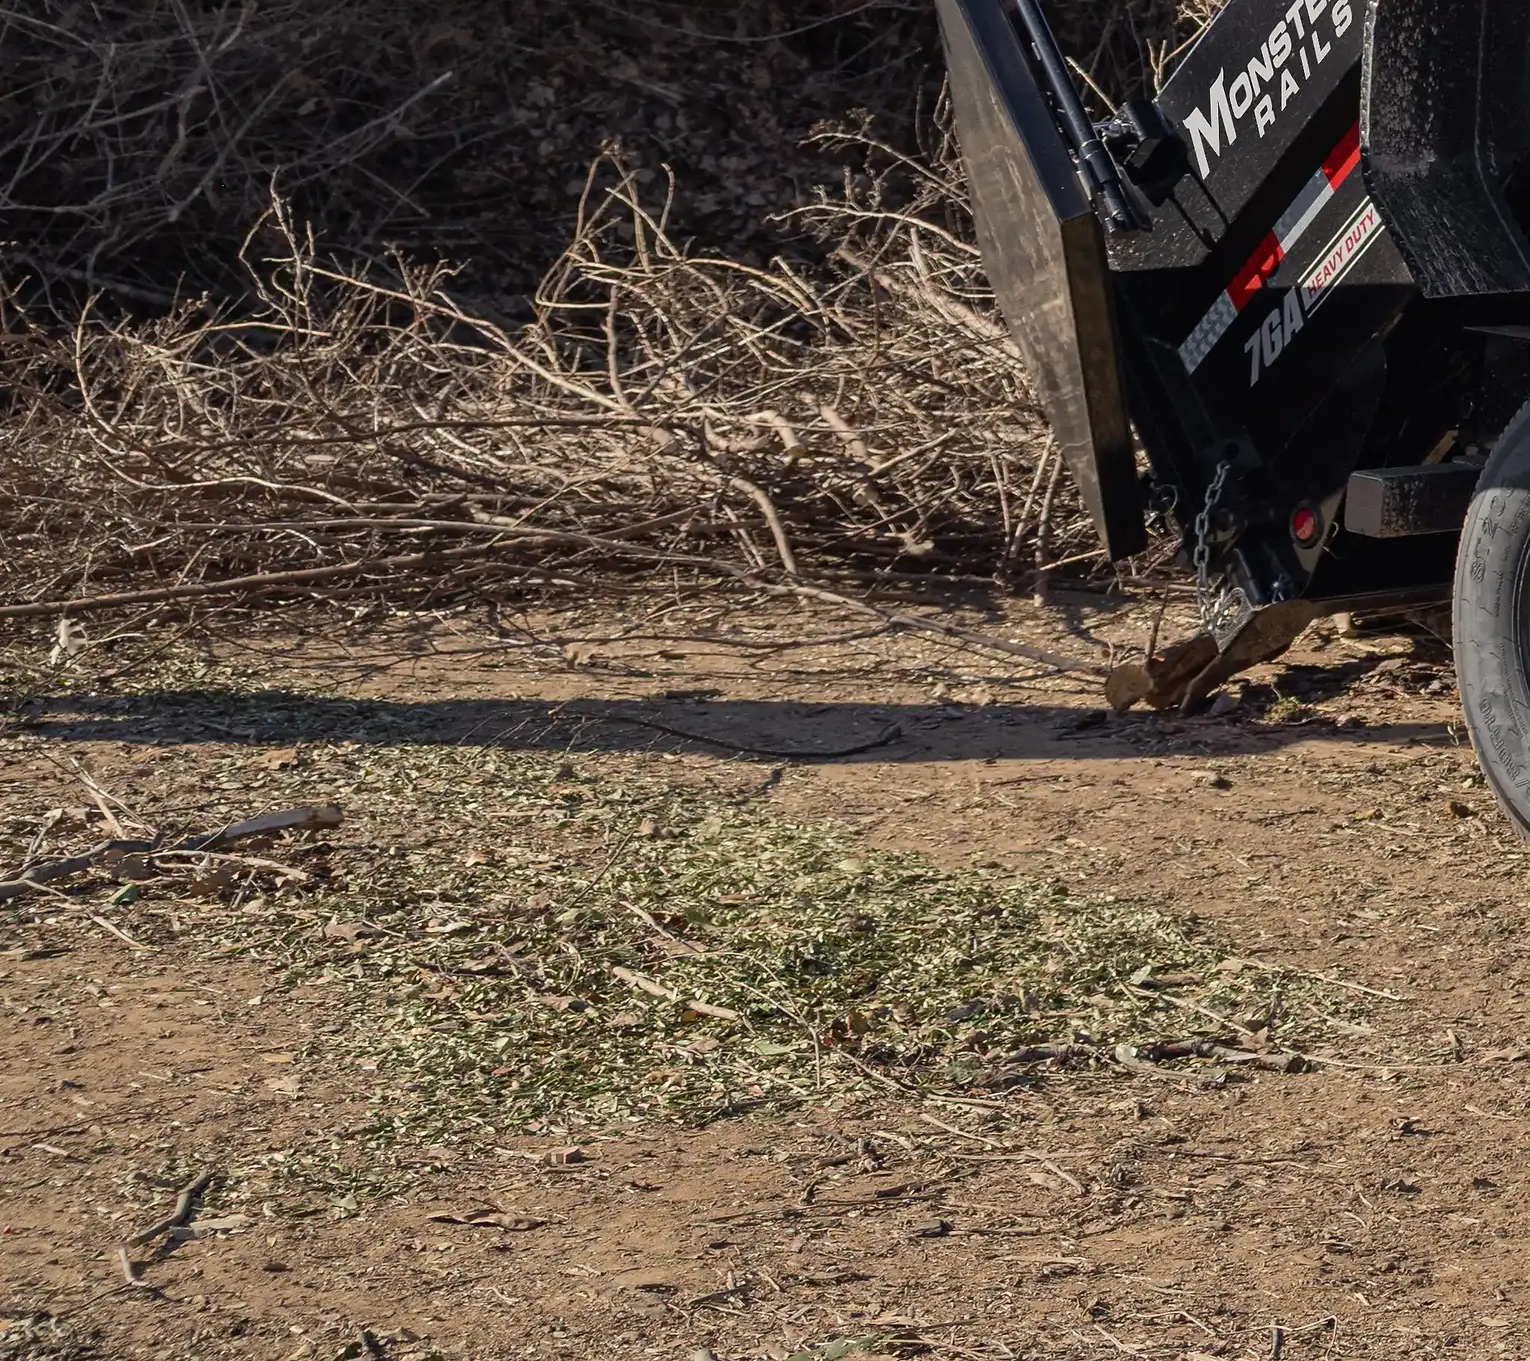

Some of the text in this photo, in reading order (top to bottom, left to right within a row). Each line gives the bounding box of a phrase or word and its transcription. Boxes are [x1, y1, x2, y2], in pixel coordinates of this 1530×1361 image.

[1244, 210, 1376, 387] 7GA HEAVY DUTY
